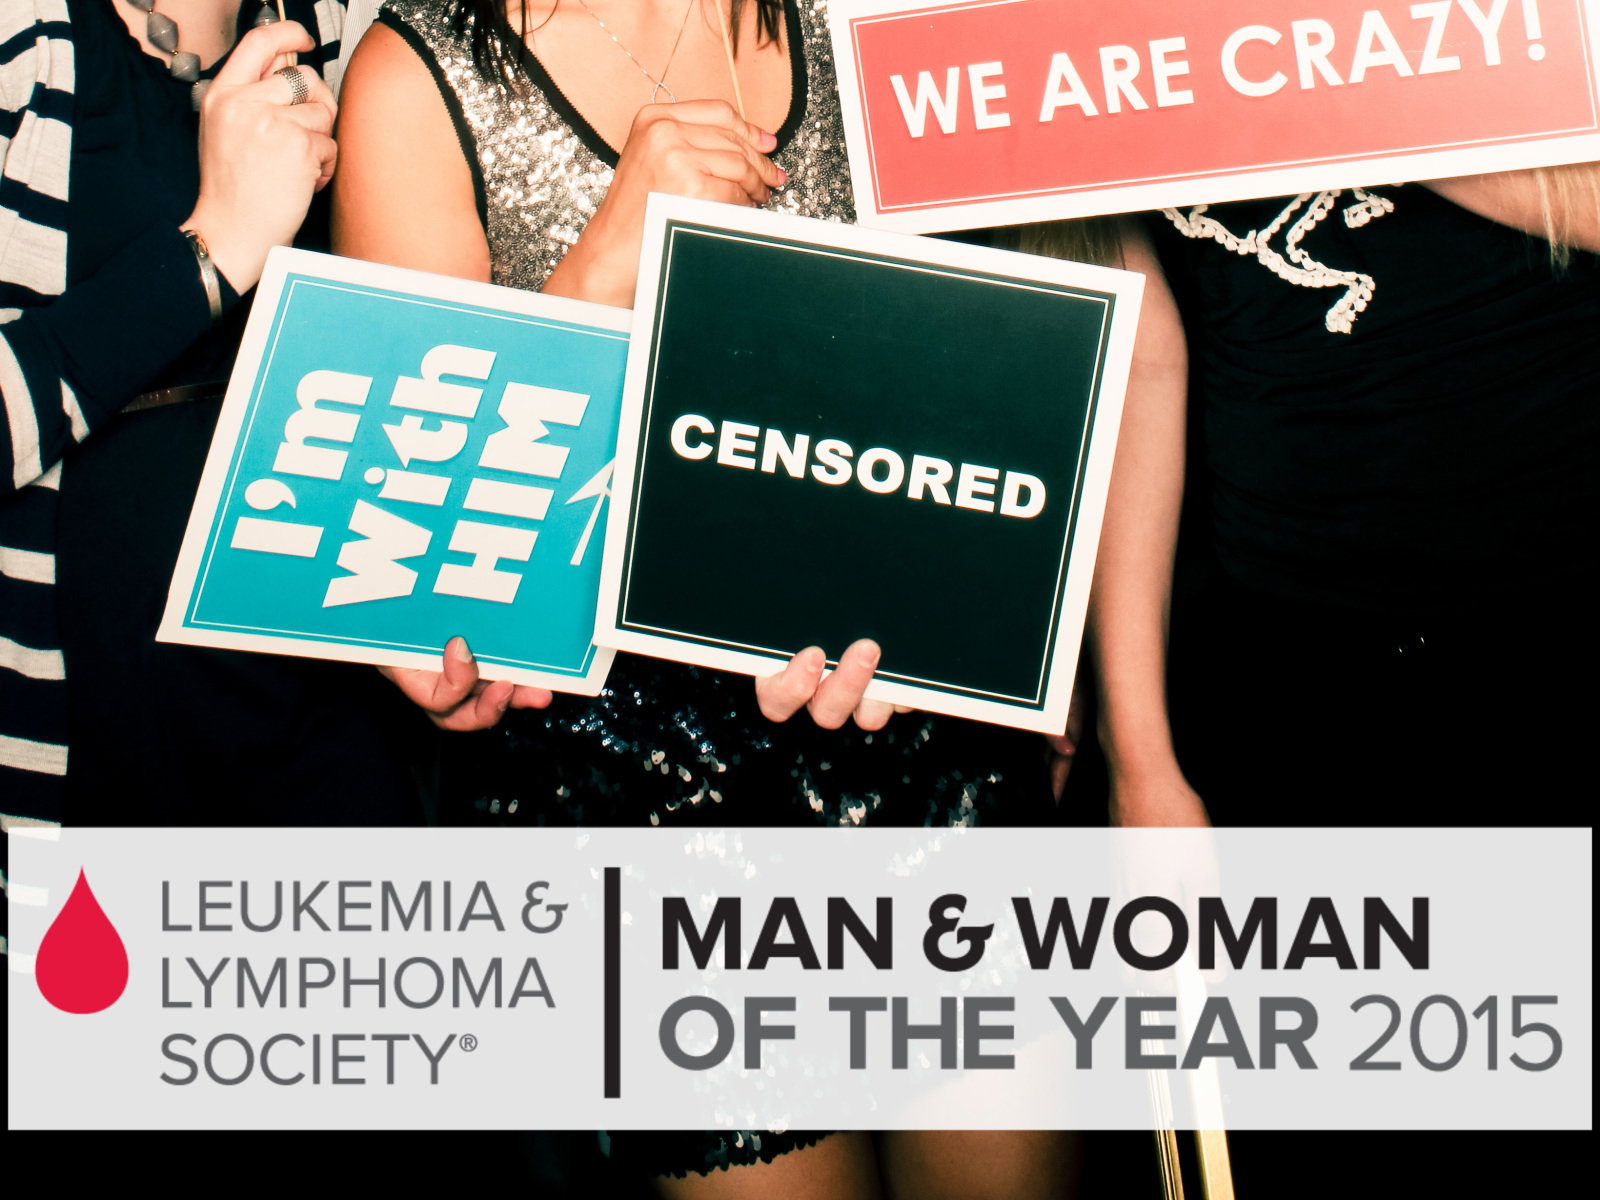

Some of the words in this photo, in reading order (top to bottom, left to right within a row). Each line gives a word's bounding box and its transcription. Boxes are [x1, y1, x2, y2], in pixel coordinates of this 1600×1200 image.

[889, 60, 1011, 139] WE
[1038, 36, 1196, 123] ARE
[230, 369, 372, 559] I'm
[322, 343, 498, 609] With
[431, 381, 592, 604] HIM
[669, 413, 1047, 520] CENSORED
